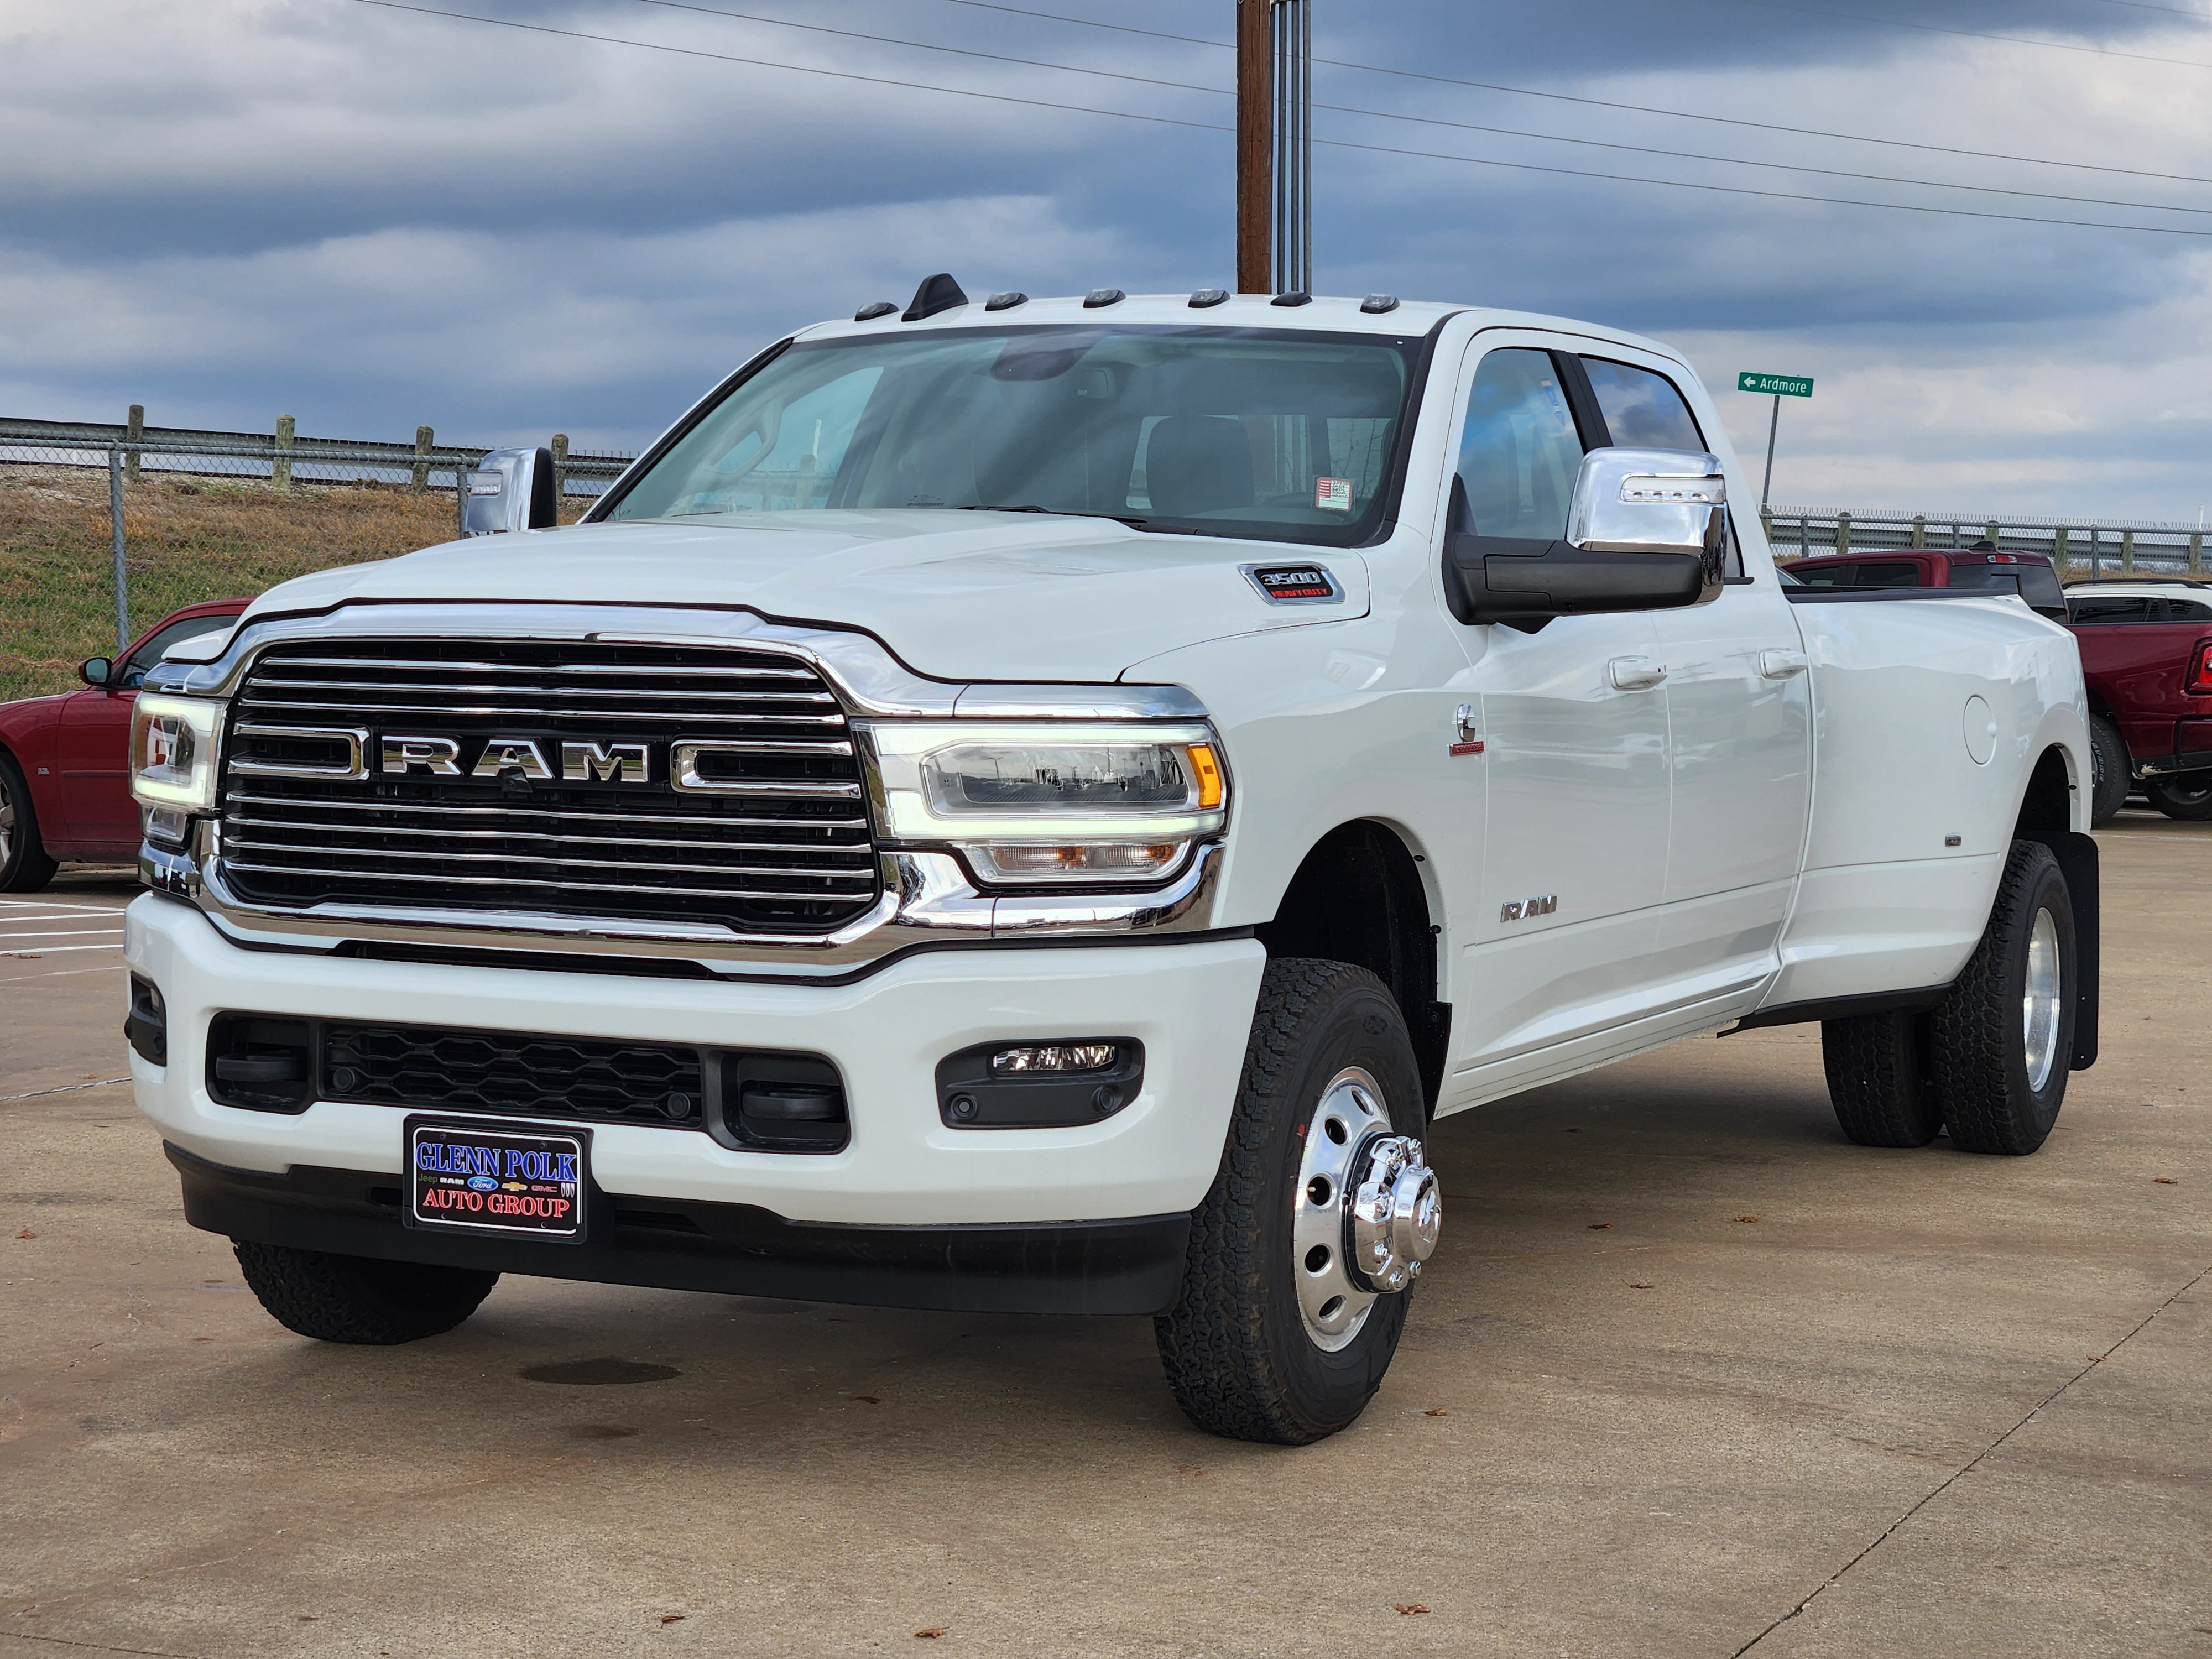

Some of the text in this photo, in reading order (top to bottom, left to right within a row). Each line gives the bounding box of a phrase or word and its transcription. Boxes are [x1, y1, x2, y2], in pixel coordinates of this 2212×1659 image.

[1759, 377, 1807, 393] Ardmore
[1260, 571, 1321, 586] 3500
[1271, 589, 1302, 597] HEAVY
[382, 735, 649, 782] RAM
[1500, 894, 1557, 922] RAM
[416, 1141, 577, 1182] GLENN POLK
[418, 1173, 558, 1193] Jeep RAM Ford GMC
[422, 1188, 570, 1218] AUTO GROUP
